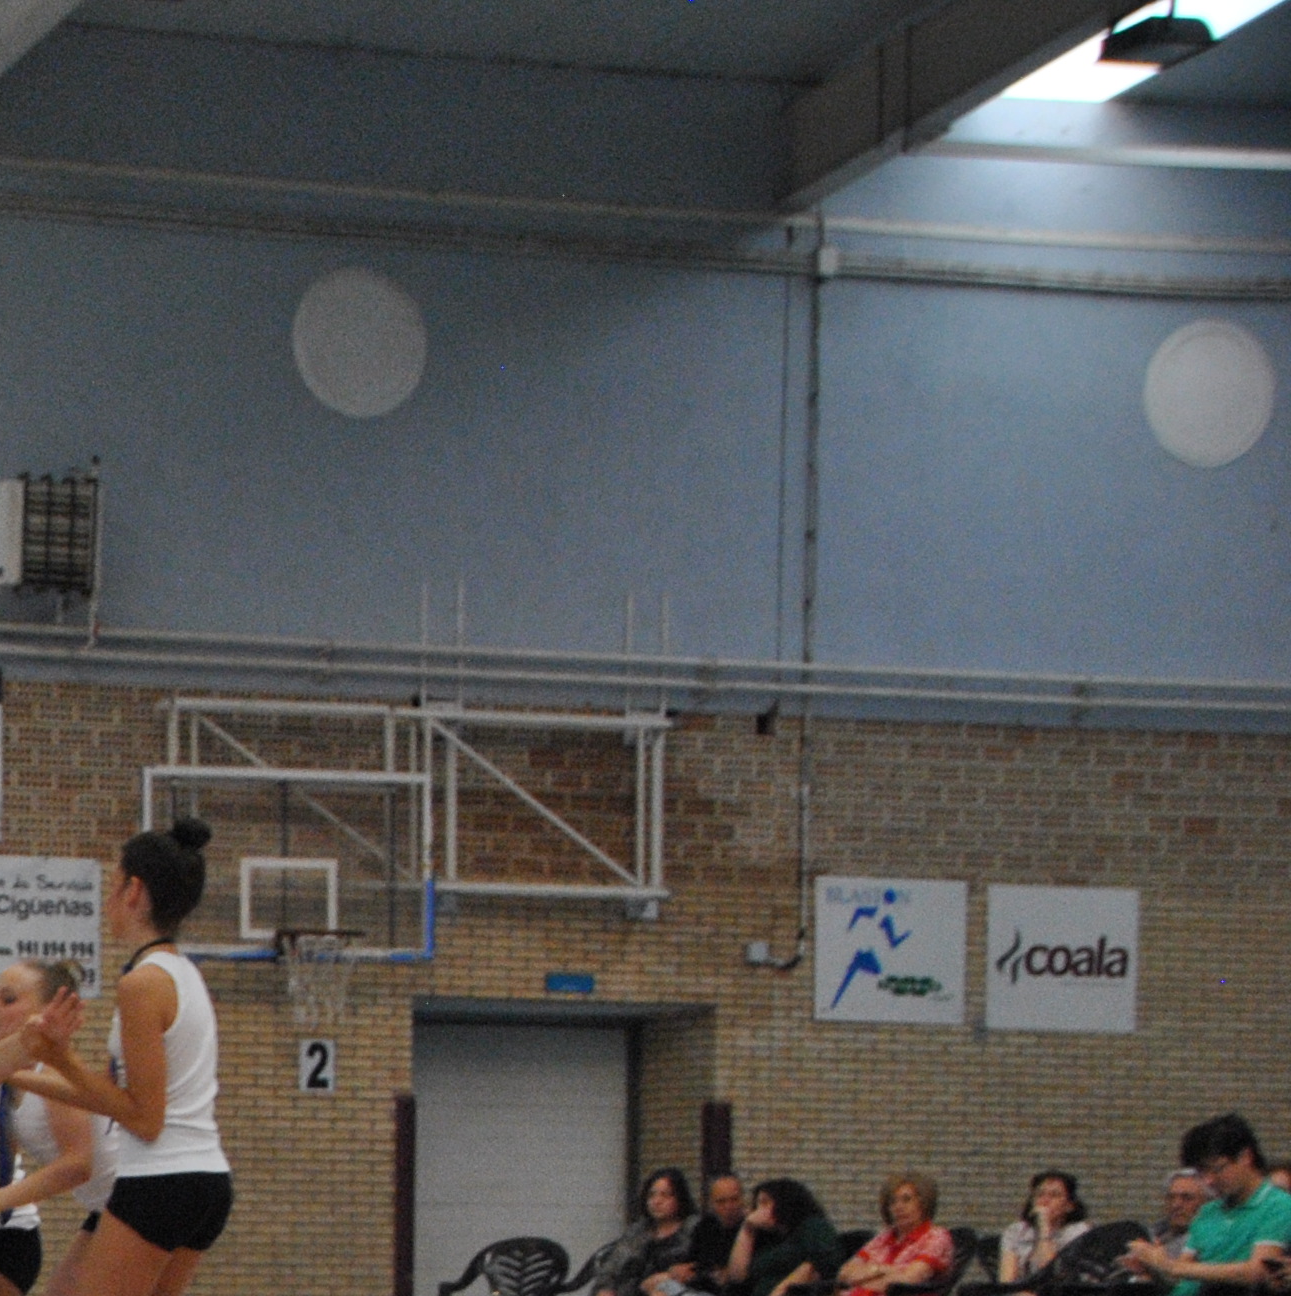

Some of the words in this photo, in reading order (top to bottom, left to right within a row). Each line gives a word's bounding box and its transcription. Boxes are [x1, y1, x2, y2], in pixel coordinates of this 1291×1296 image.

[36, 873, 94, 892] Servicio
[1024, 935, 1129, 979] coala
[305, 1040, 330, 1090] 2
